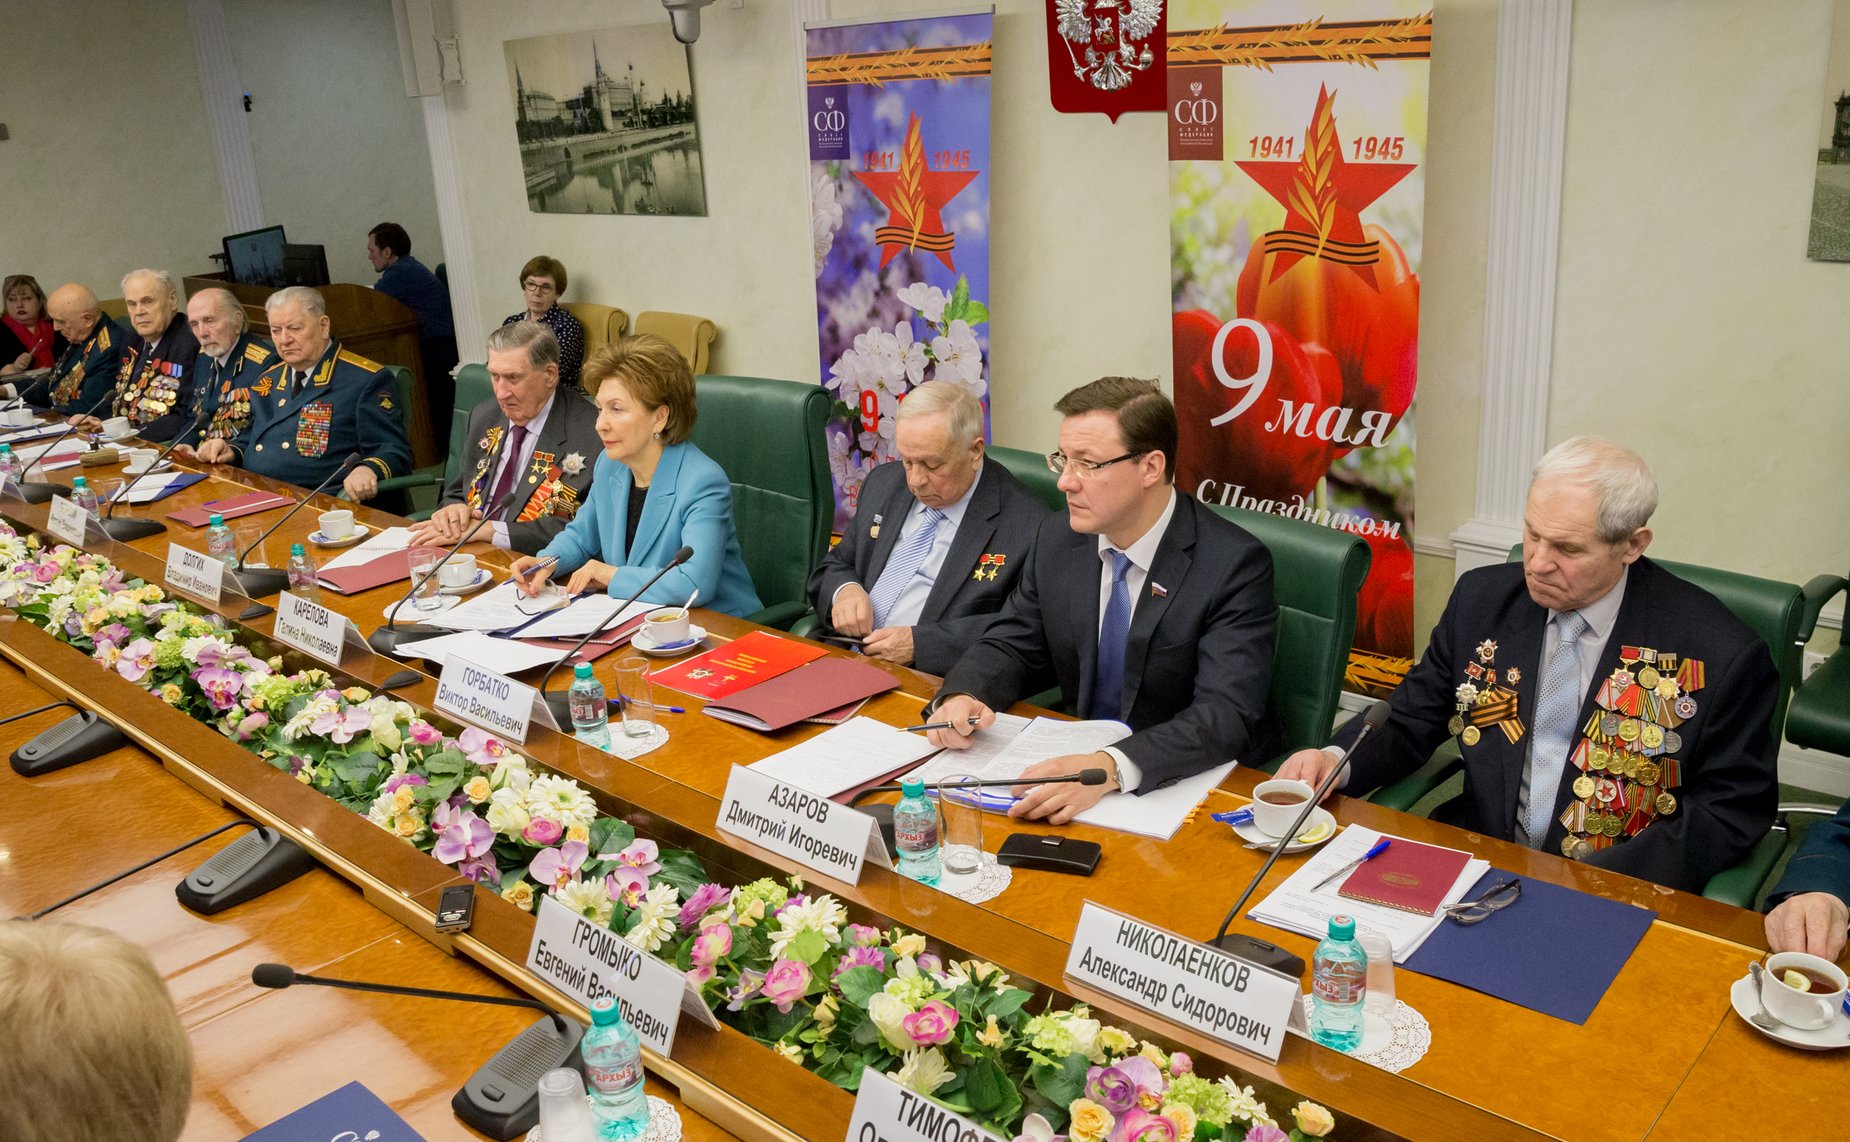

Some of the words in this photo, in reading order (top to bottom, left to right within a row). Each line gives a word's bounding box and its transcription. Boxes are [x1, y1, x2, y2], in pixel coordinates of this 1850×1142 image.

[814, 110, 845, 131] СФ
[1174, 98, 1217, 126] СФ
[864, 151, 894, 170] 1941
[934, 150, 971, 169] 1945
[1249, 135, 1294, 158] 1941
[1353, 136, 1404, 161] 1945
[1210, 317, 1274, 427] 9
[1264, 398, 1393, 448] мая
[861, 389, 879, 433] 9
[1196, 479, 1217, 504] С
[1219, 482, 1401, 540] Праздником
[293, 599, 329, 628] КАРЕЛОВА
[278, 617, 300, 640] Галина
[300, 626, 338, 657] Николаевна
[462, 667, 510, 701] ГОРБАТКО
[438, 683, 469, 713] Виктор
[469, 697, 523, 735] Васильевич
[768, 784, 829, 824] АЗАРОВ
[725, 800, 787, 841] Дмитрий
[788, 824, 858, 871] Игоревич
[534, 939, 586, 993] Евгений
[572, 919, 642, 981] ГРОМЫКО
[1116, 919, 1250, 993] НИКОЛАЕНКОВ
[1078, 946, 1167, 1007] Александр
[1172, 983, 1271, 1046] Сидорович
[596, 1068, 631, 1082] АРХЫЗ
[898, 1090, 995, 1142] ТИМО
